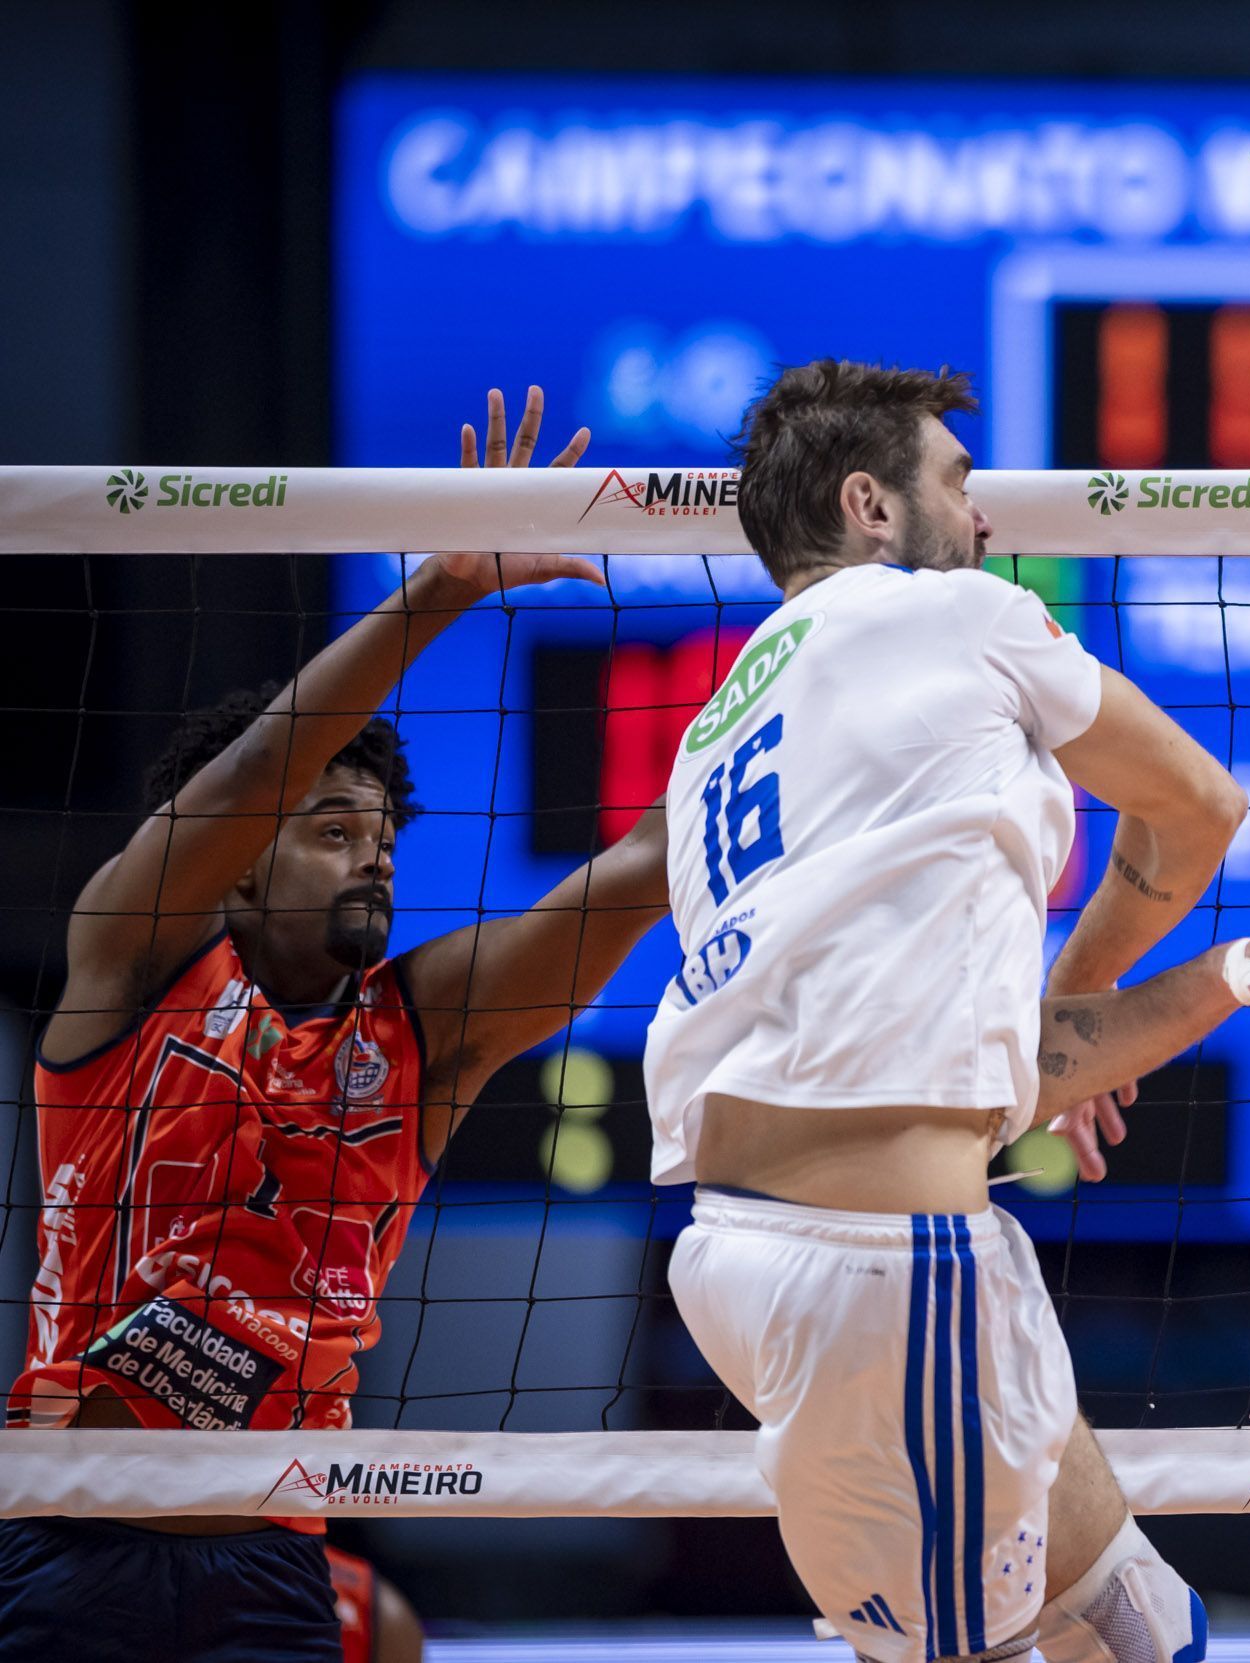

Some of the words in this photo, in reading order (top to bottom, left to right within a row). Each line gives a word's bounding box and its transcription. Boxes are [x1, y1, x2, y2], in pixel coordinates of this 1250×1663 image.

[156, 474, 288, 507] Sicredi
[645, 472, 741, 507] MINE
[687, 472, 739, 480] CAMPE
[647, 507, 666, 516] DE
[696, 631, 797, 743] SADA
[701, 713, 785, 908] 16
[144, 1297, 257, 1379] Faculdade
[226, 1304, 299, 1363] Aracoop
[107, 1351, 140, 1377] de
[126, 1326, 157, 1353] de
[156, 1340, 249, 1414] Medicina
[325, 1463, 483, 1496] MINEIRO
[368, 1462, 474, 1472] CAMPEONATO
[327, 1495, 346, 1505] DE
